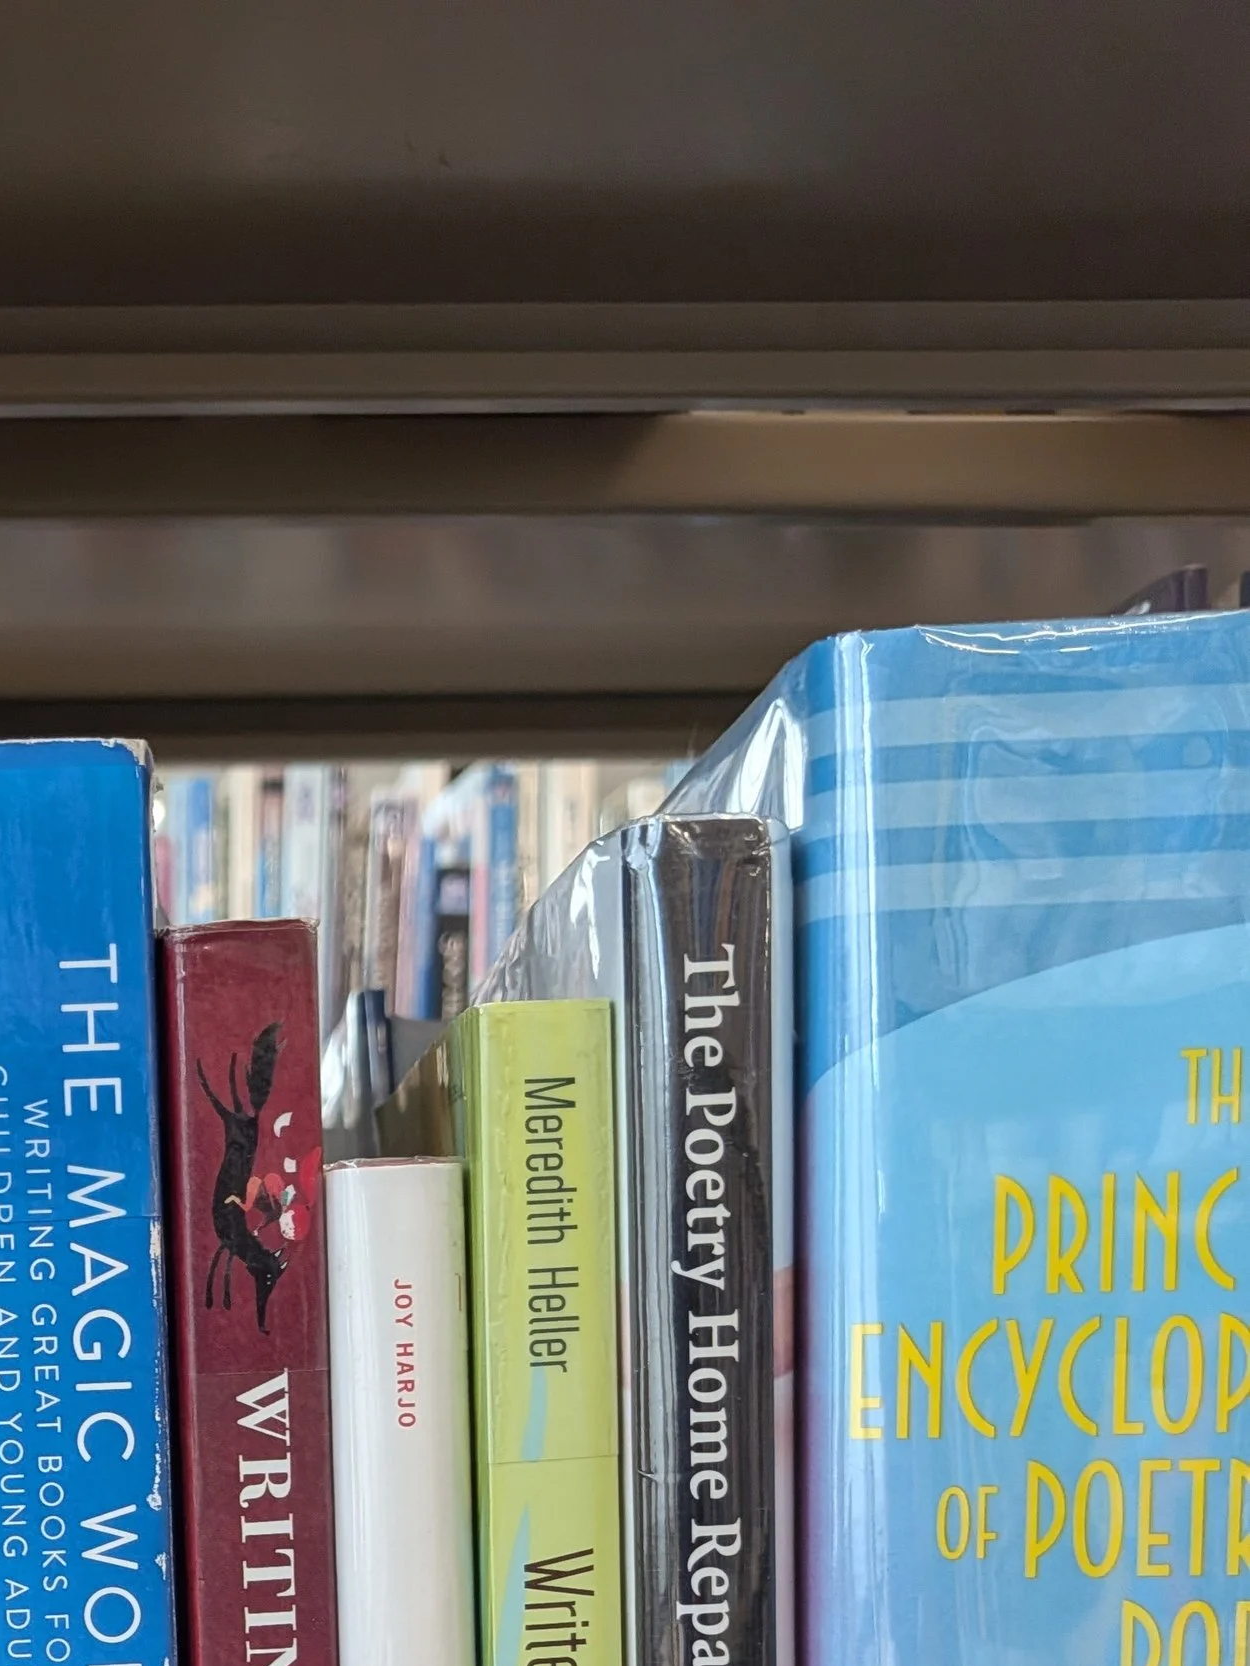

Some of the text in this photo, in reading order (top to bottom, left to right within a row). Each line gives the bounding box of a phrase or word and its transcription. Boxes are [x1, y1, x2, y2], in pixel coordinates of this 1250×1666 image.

[59, 943, 122, 1116] THE
[683, 943, 740, 1068] The
[22, 1098, 56, 1282] WRITING
[523, 1076, 581, 1373] Meredith Heller
[670, 1086, 737, 1291] Poetry
[31, 1303, 62, 1433] GREAT
[66, 1164, 136, 1462] MAGIC
[394, 1278, 417, 1429] JOY HARJO
[686, 1307, 740, 1501] Home
[37, 1455, 67, 1592] BOOKS
[935, 1485, 1000, 1561] OF
